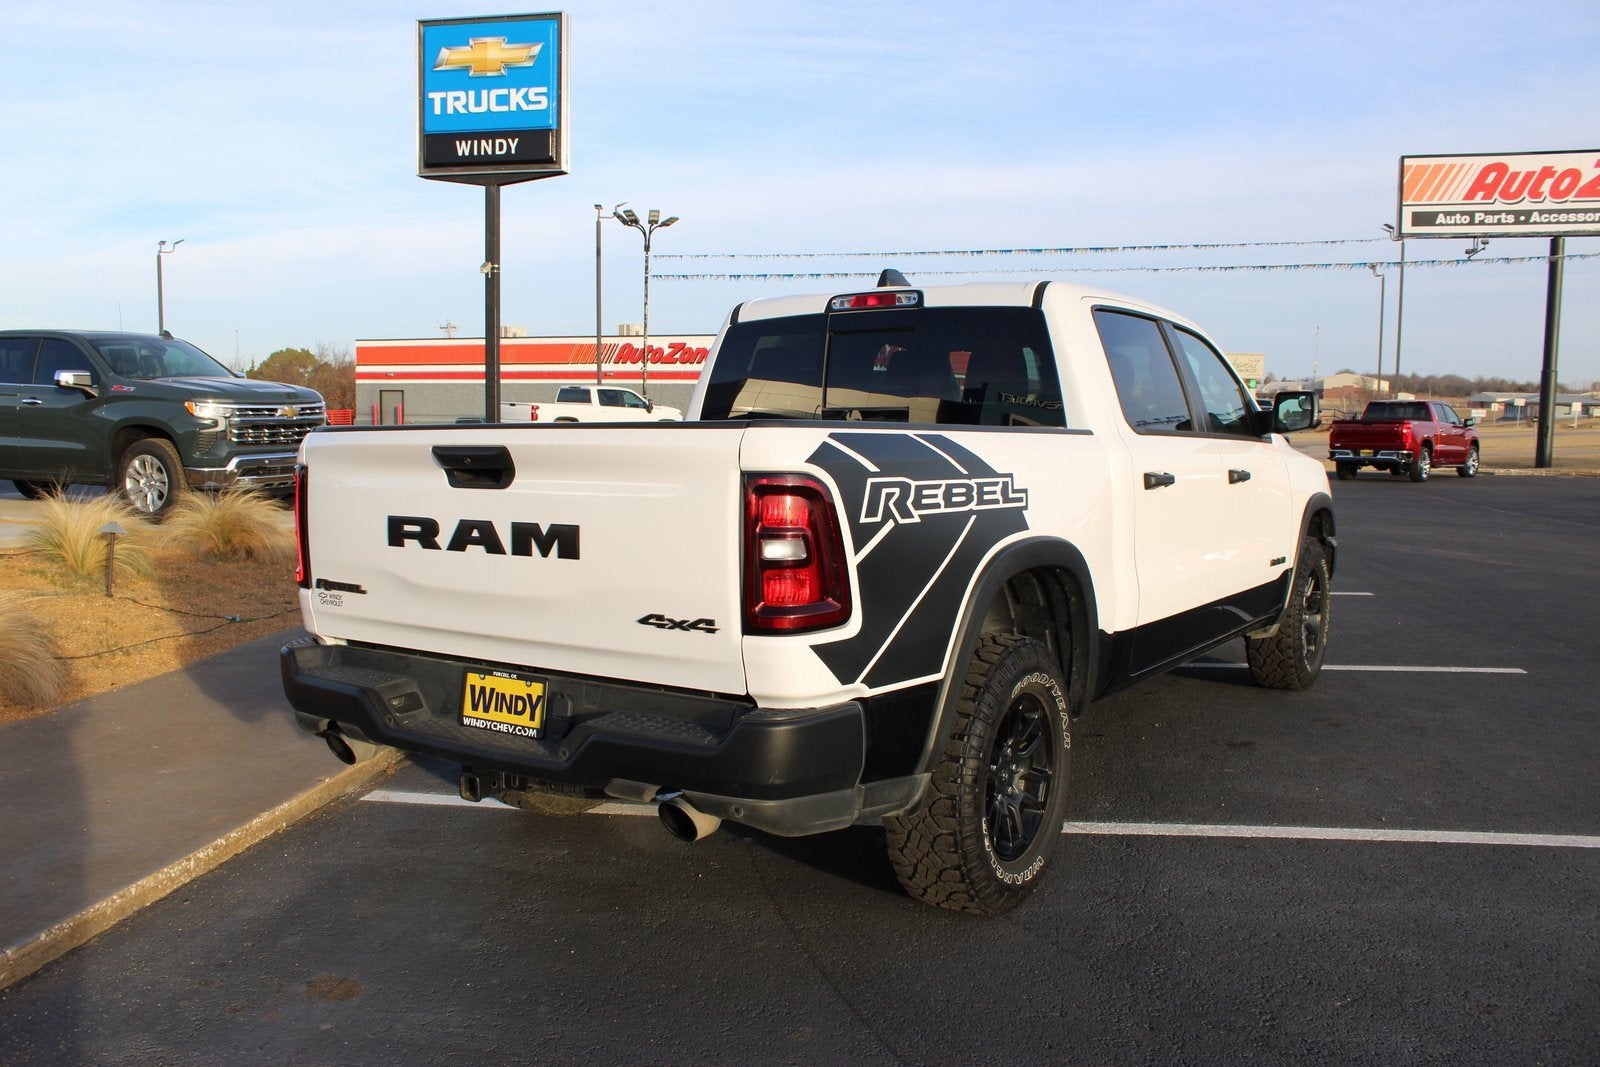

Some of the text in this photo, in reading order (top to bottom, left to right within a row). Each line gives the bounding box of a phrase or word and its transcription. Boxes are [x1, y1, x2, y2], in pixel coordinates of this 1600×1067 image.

[428, 86, 548, 115] TRUCKS
[455, 138, 519, 157] WINDY
[1435, 213, 1470, 224] Auto
[1474, 212, 1515, 224] Parts
[860, 476, 1028, 524] REBEL
[387, 515, 580, 560] RAM
[636, 613, 720, 634] 4x4
[463, 716, 537, 738] WINDYCHEV.COM
